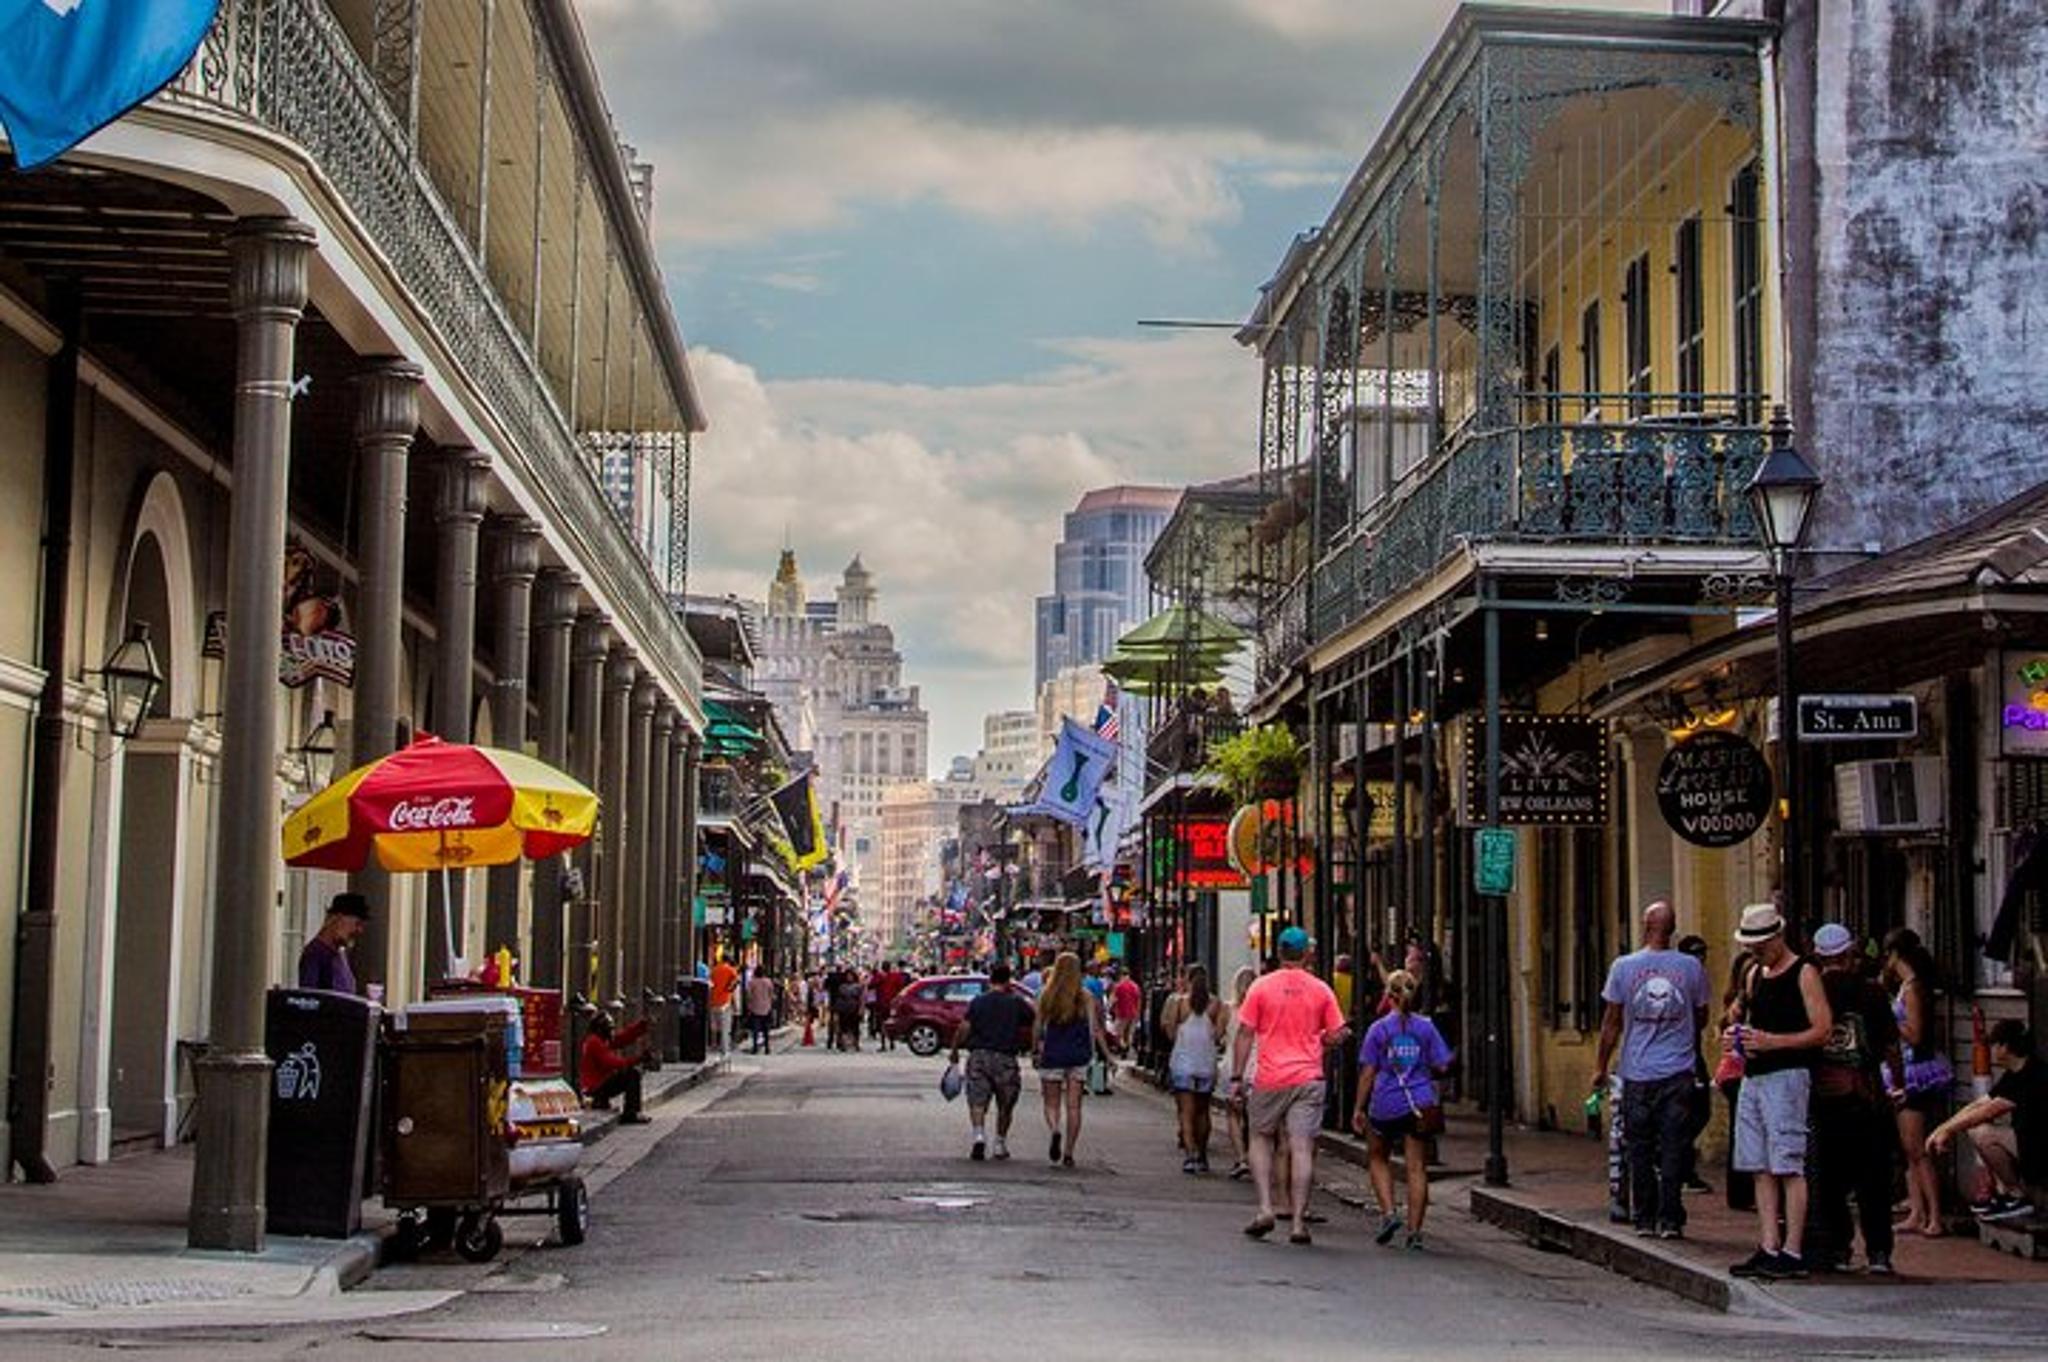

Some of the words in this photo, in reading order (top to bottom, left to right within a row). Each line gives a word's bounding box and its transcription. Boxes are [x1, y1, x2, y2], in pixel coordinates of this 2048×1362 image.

[1813, 709, 1844, 731] St.
[1853, 709, 1901, 730] Ann
[1670, 747, 1751, 769] MARIE
[1499, 796, 1523, 811] EW
[1524, 796, 1594, 812] ORLEANS
[1680, 788, 1749, 808] HOUSE
[388, 796, 476, 832] Coca-Cola
[1681, 812, 1757, 834] VOODOO
